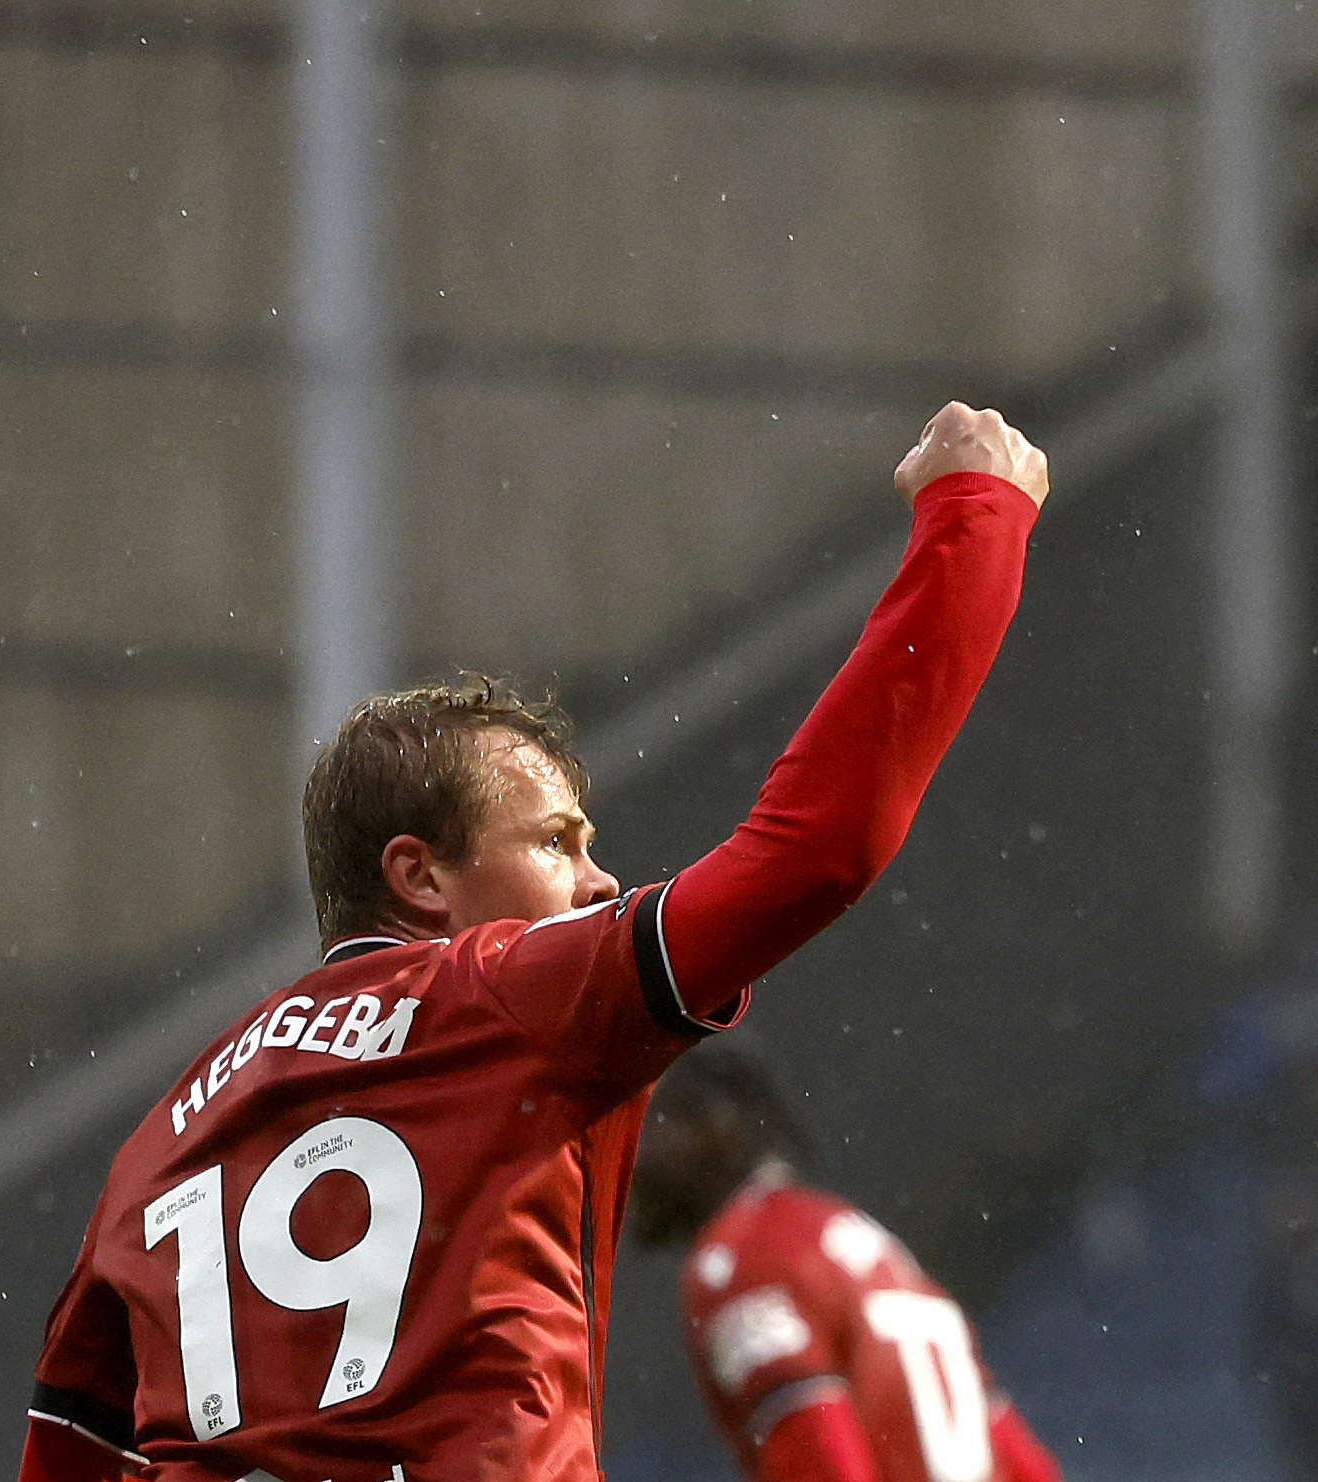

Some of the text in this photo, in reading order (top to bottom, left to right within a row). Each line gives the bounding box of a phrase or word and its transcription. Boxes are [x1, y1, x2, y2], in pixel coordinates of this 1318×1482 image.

[308, 1138, 353, 1165] COMMUNITY
[144, 1115, 423, 1442] 19
[346, 1380, 365, 1393] EFL
[207, 1417, 224, 1431] EFL
